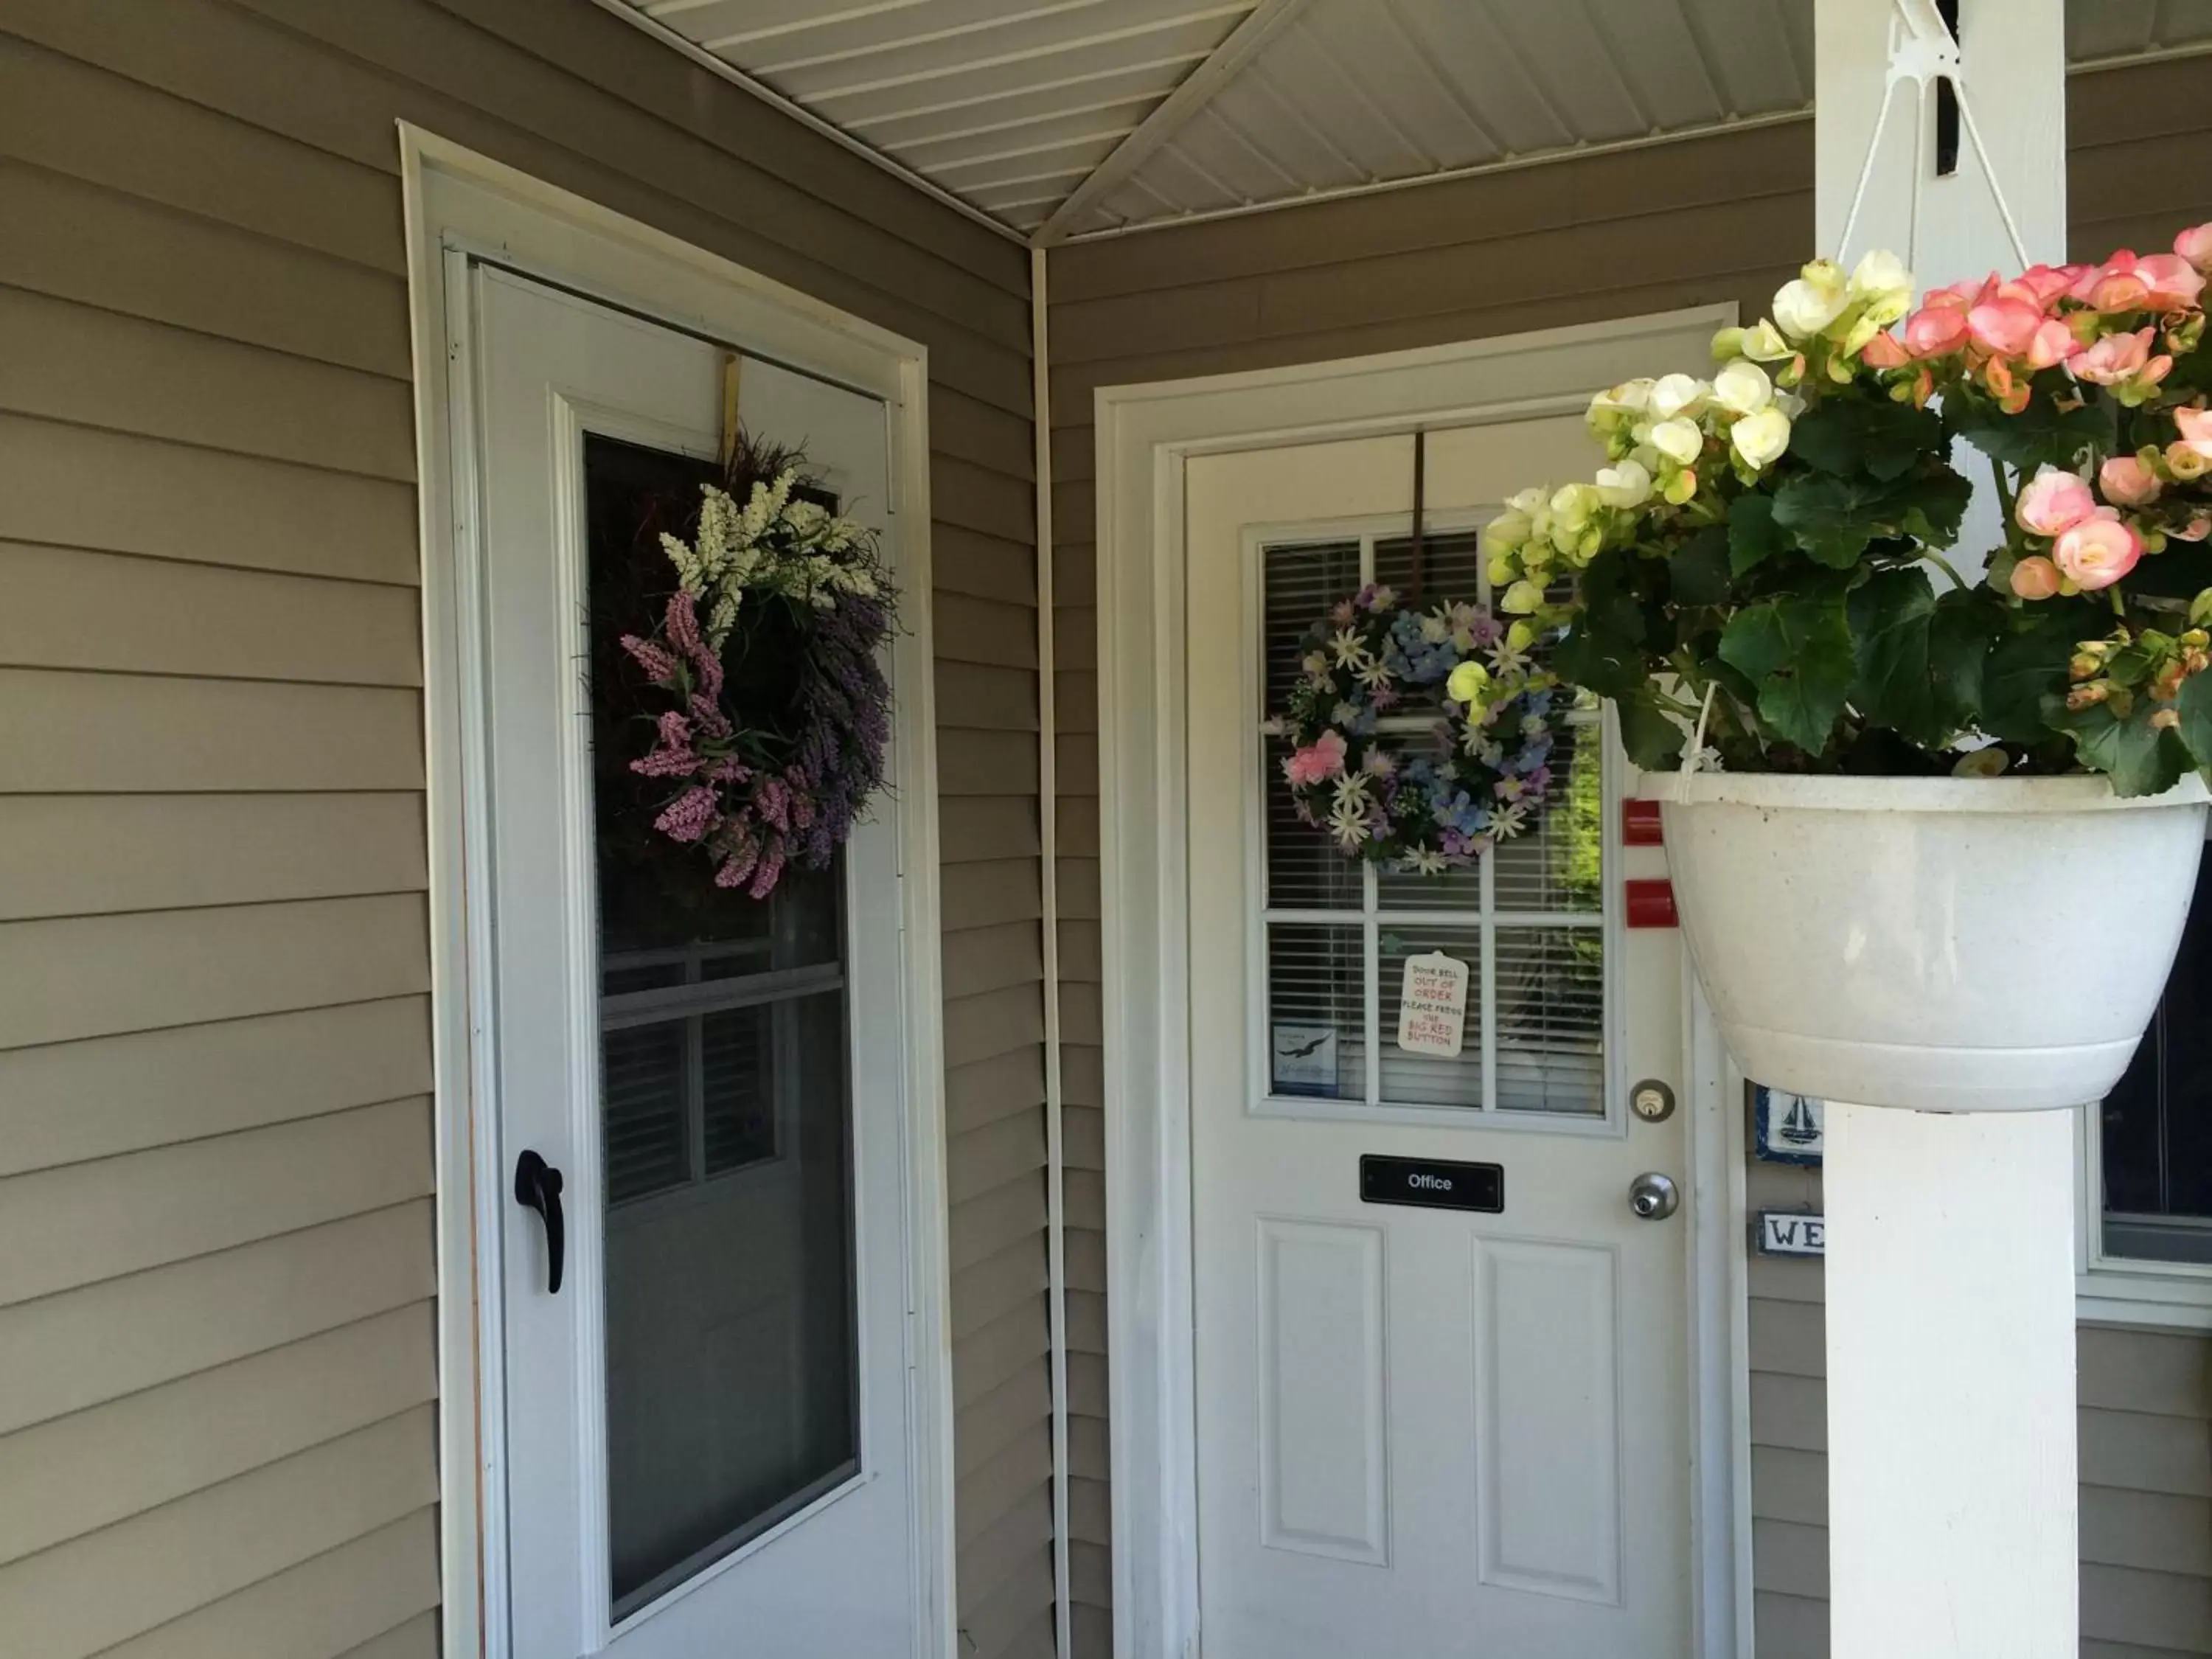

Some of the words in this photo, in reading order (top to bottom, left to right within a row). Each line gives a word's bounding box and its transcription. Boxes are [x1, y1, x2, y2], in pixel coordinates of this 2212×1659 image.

[1439, 967, 1458, 978] BELL
[1414, 976, 1438, 987] OUT
[1440, 979, 1455, 990] OF
[1414, 989, 1453, 1001] ORDER
[1402, 1000, 1433, 1012] PLEASE
[1408, 1019, 1427, 1032] BIG
[1430, 1023, 1453, 1036] RED
[1408, 1031, 1450, 1046] BUTTON
[1408, 1173, 1453, 1191] Office
